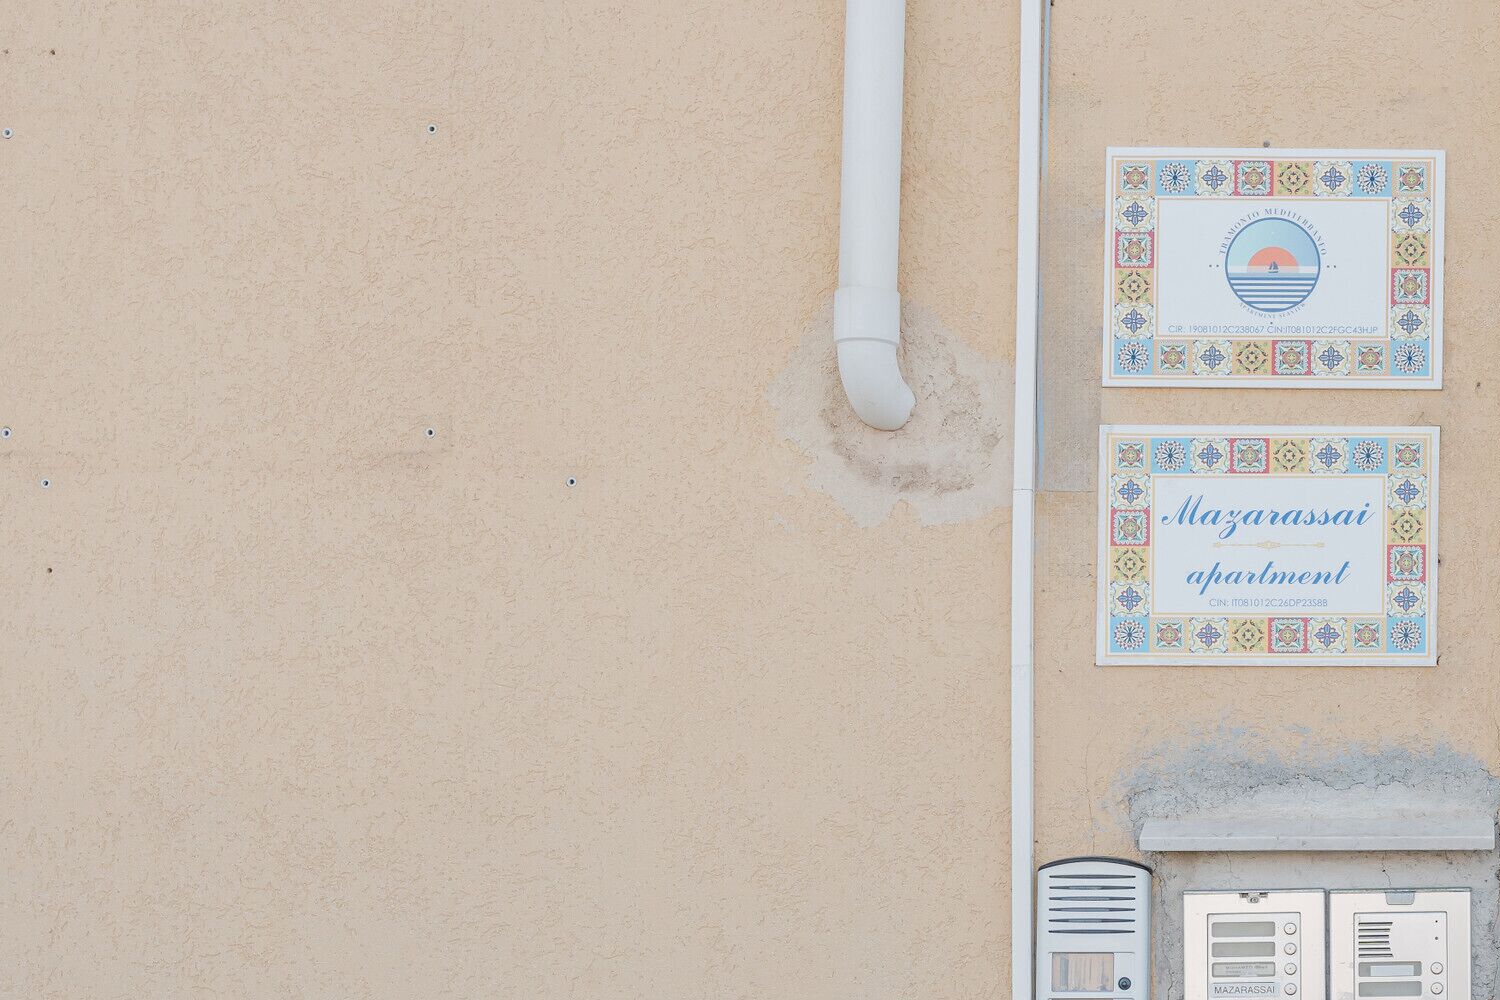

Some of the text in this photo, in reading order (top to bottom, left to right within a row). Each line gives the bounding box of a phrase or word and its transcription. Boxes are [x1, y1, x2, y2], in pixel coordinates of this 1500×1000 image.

[1219, 211, 1260, 255] TRAMONTO
[1161, 494, 1375, 540] Mazarassai
[1186, 561, 1350, 595] apartment
[1209, 598, 1229, 608] CIN:
[1214, 985, 1275, 994] MAZARASSAI
